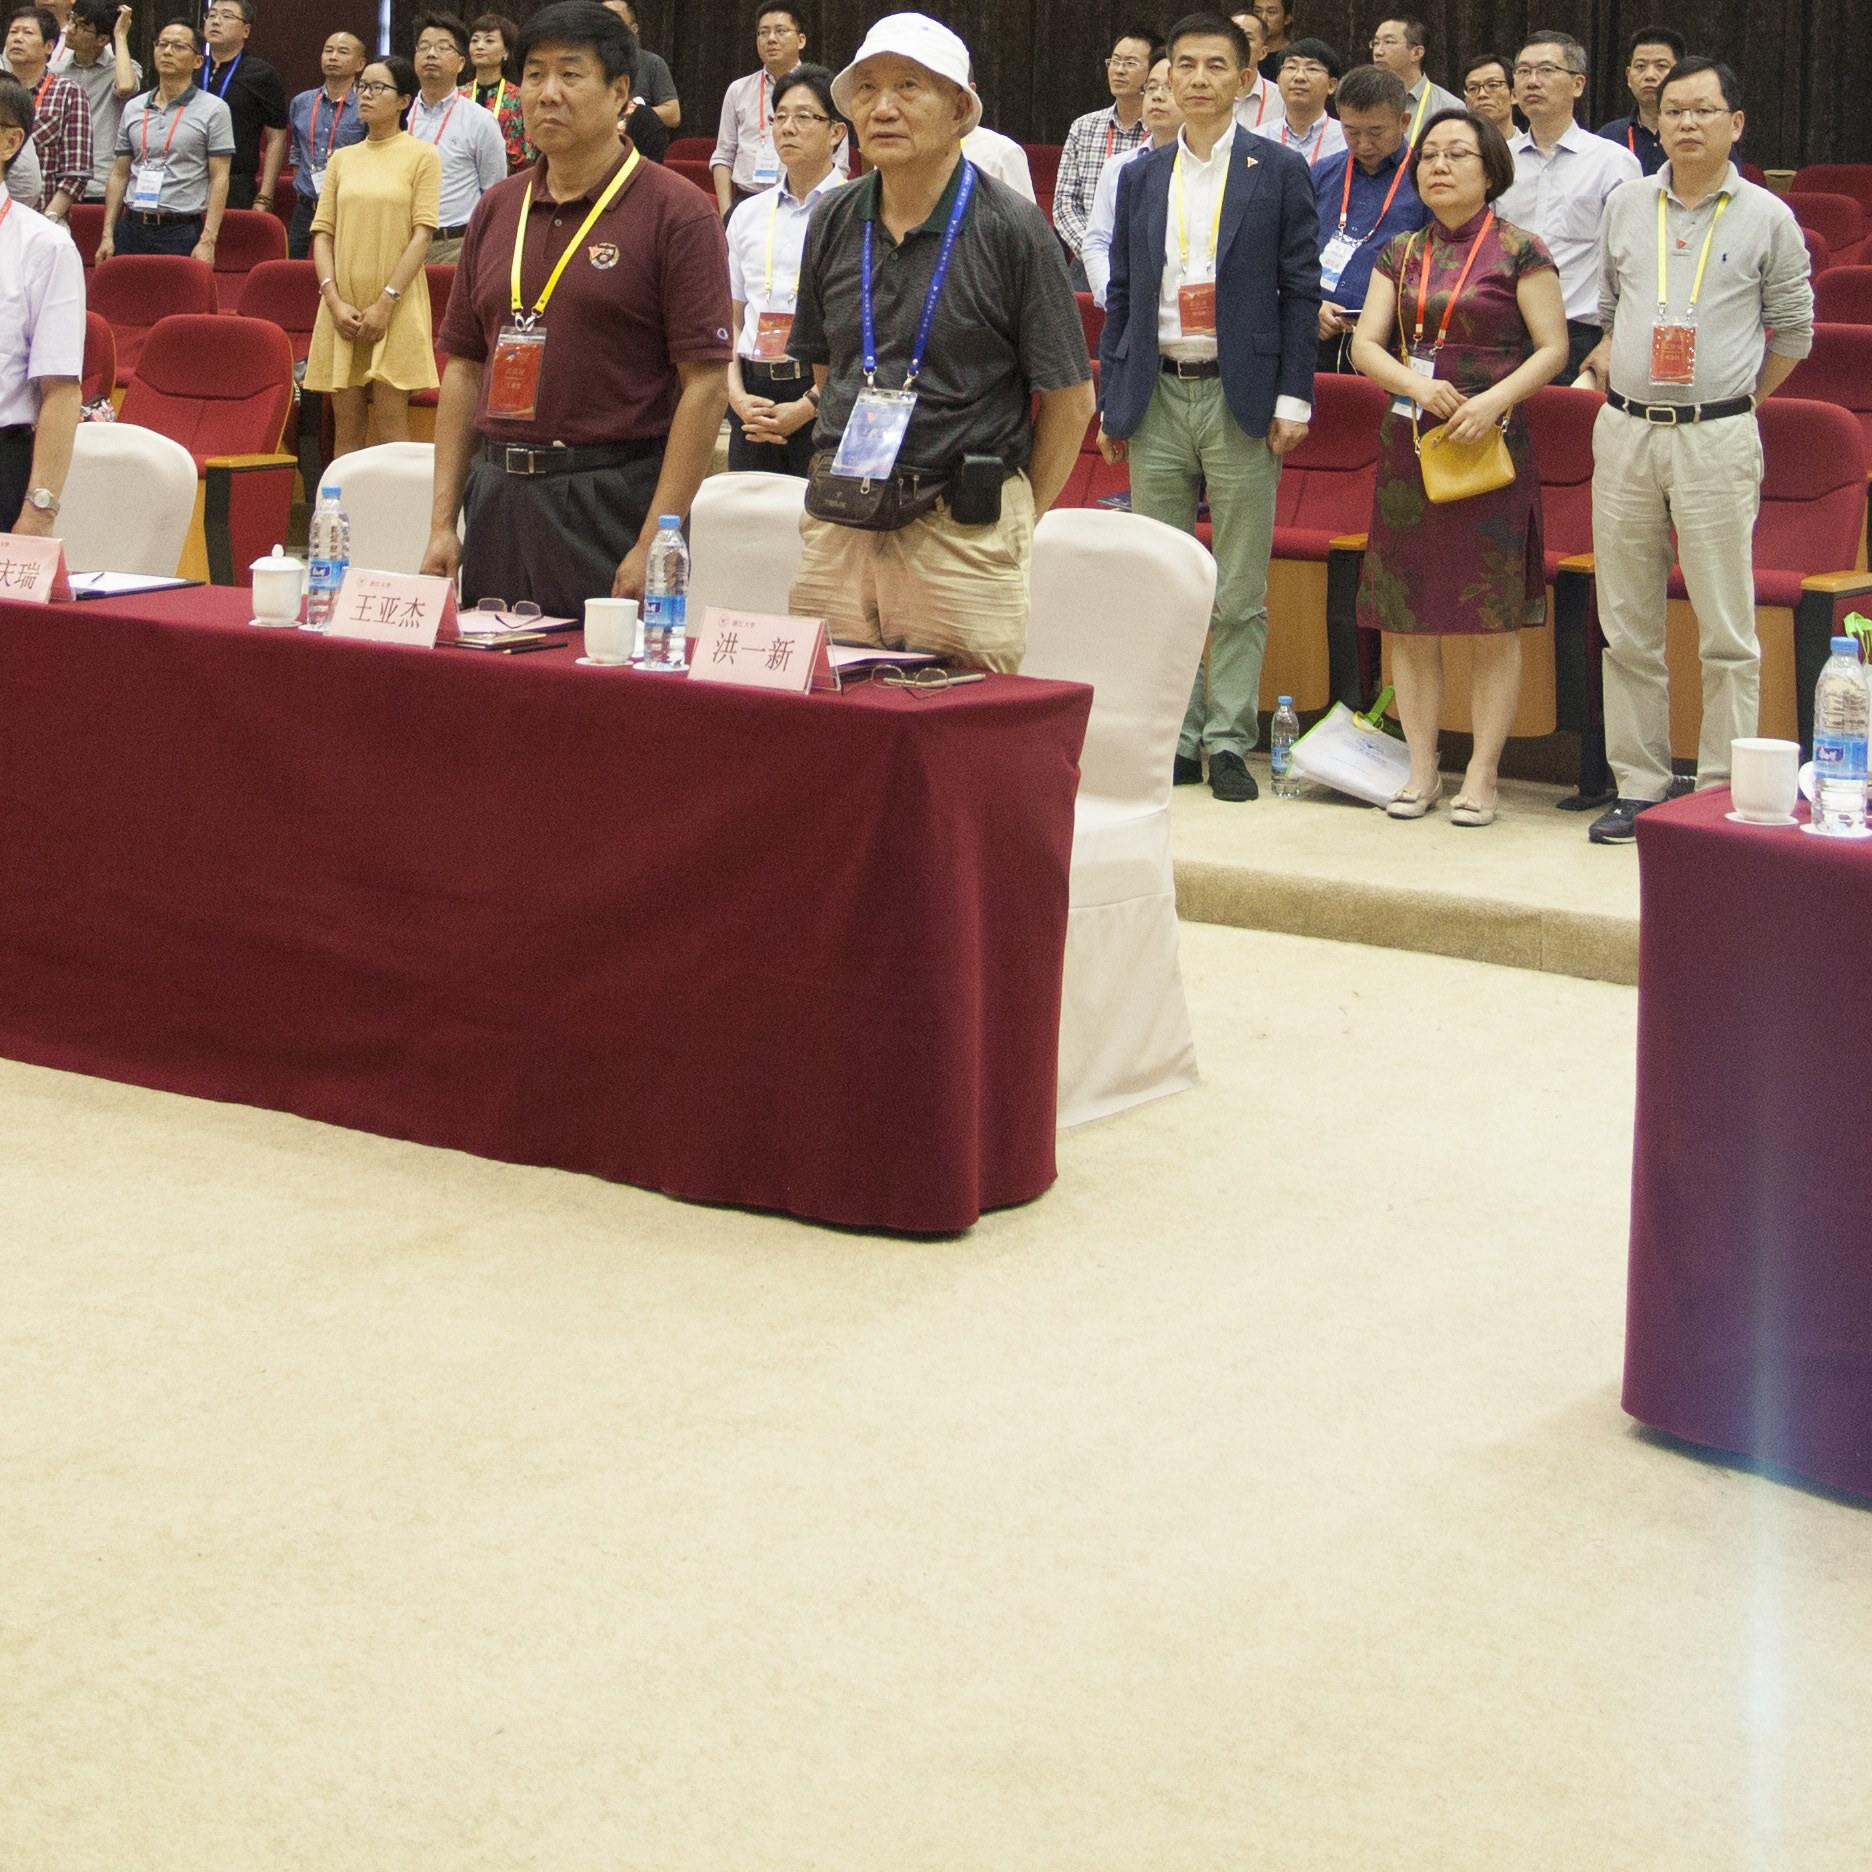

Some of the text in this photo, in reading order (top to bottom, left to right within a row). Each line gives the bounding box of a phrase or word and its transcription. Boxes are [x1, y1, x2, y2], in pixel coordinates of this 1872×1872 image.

[348, 593, 427, 630] 王亚杰
[711, 631, 795, 673] 洪一新
